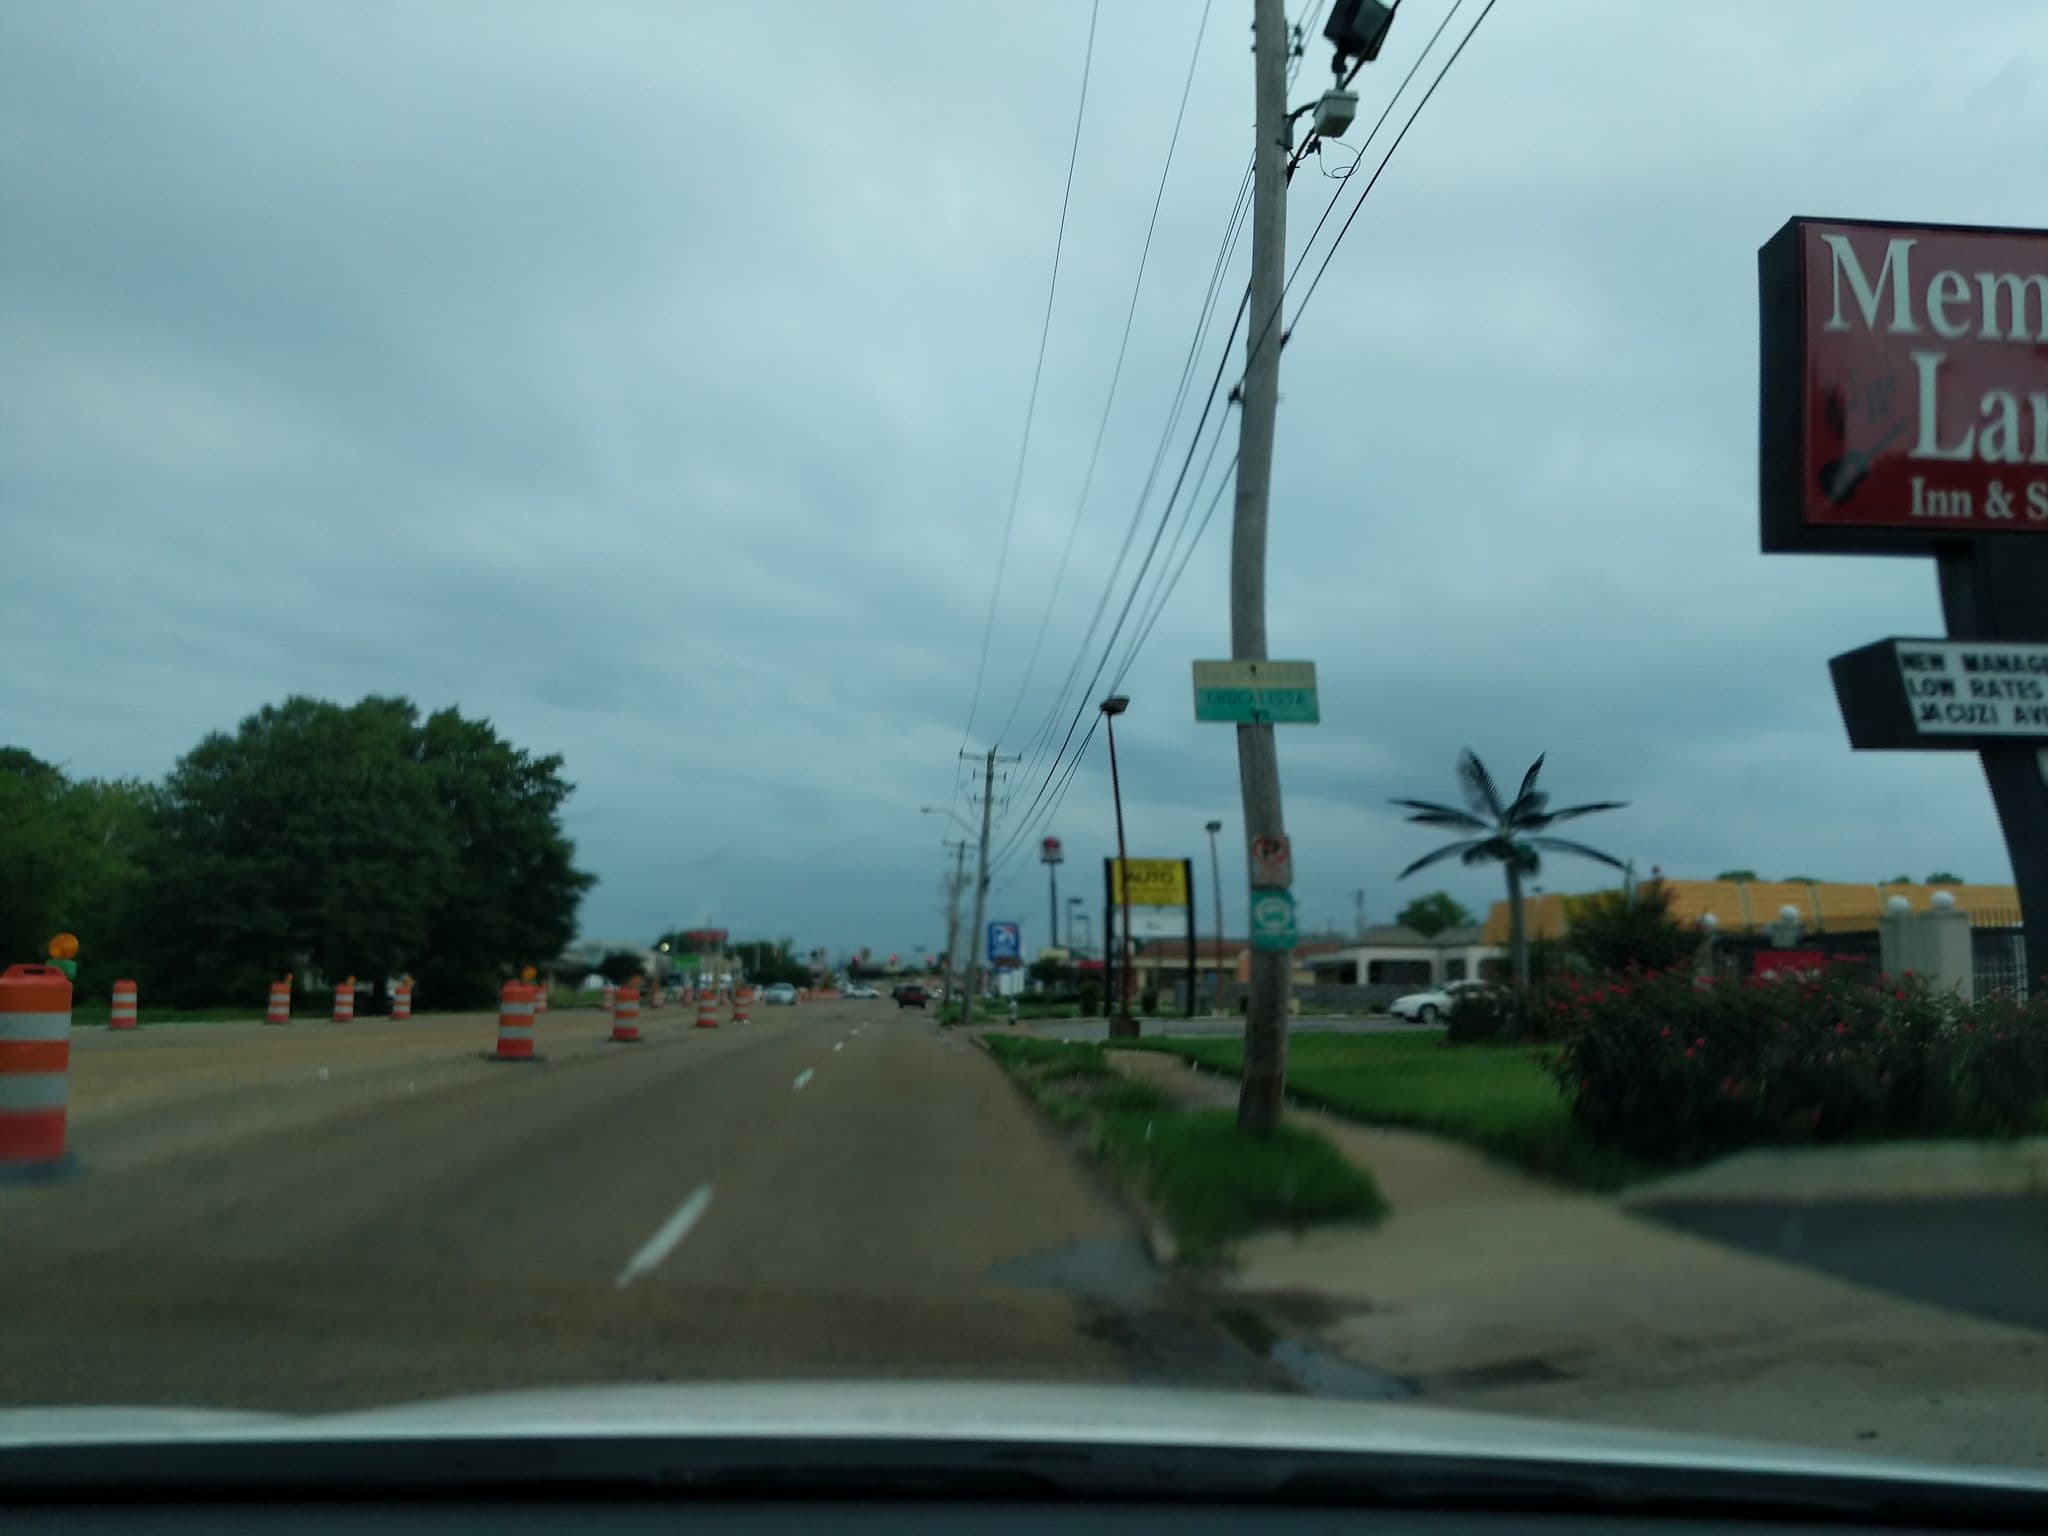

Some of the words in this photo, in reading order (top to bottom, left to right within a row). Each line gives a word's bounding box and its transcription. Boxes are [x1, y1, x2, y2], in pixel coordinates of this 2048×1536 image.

[1910, 476, 1973, 519] Inn
[1985, 480, 2015, 520] &
[1902, 653, 1946, 671] NEW
[1906, 677, 1955, 698] LOW
[1968, 677, 2044, 700] RATES
